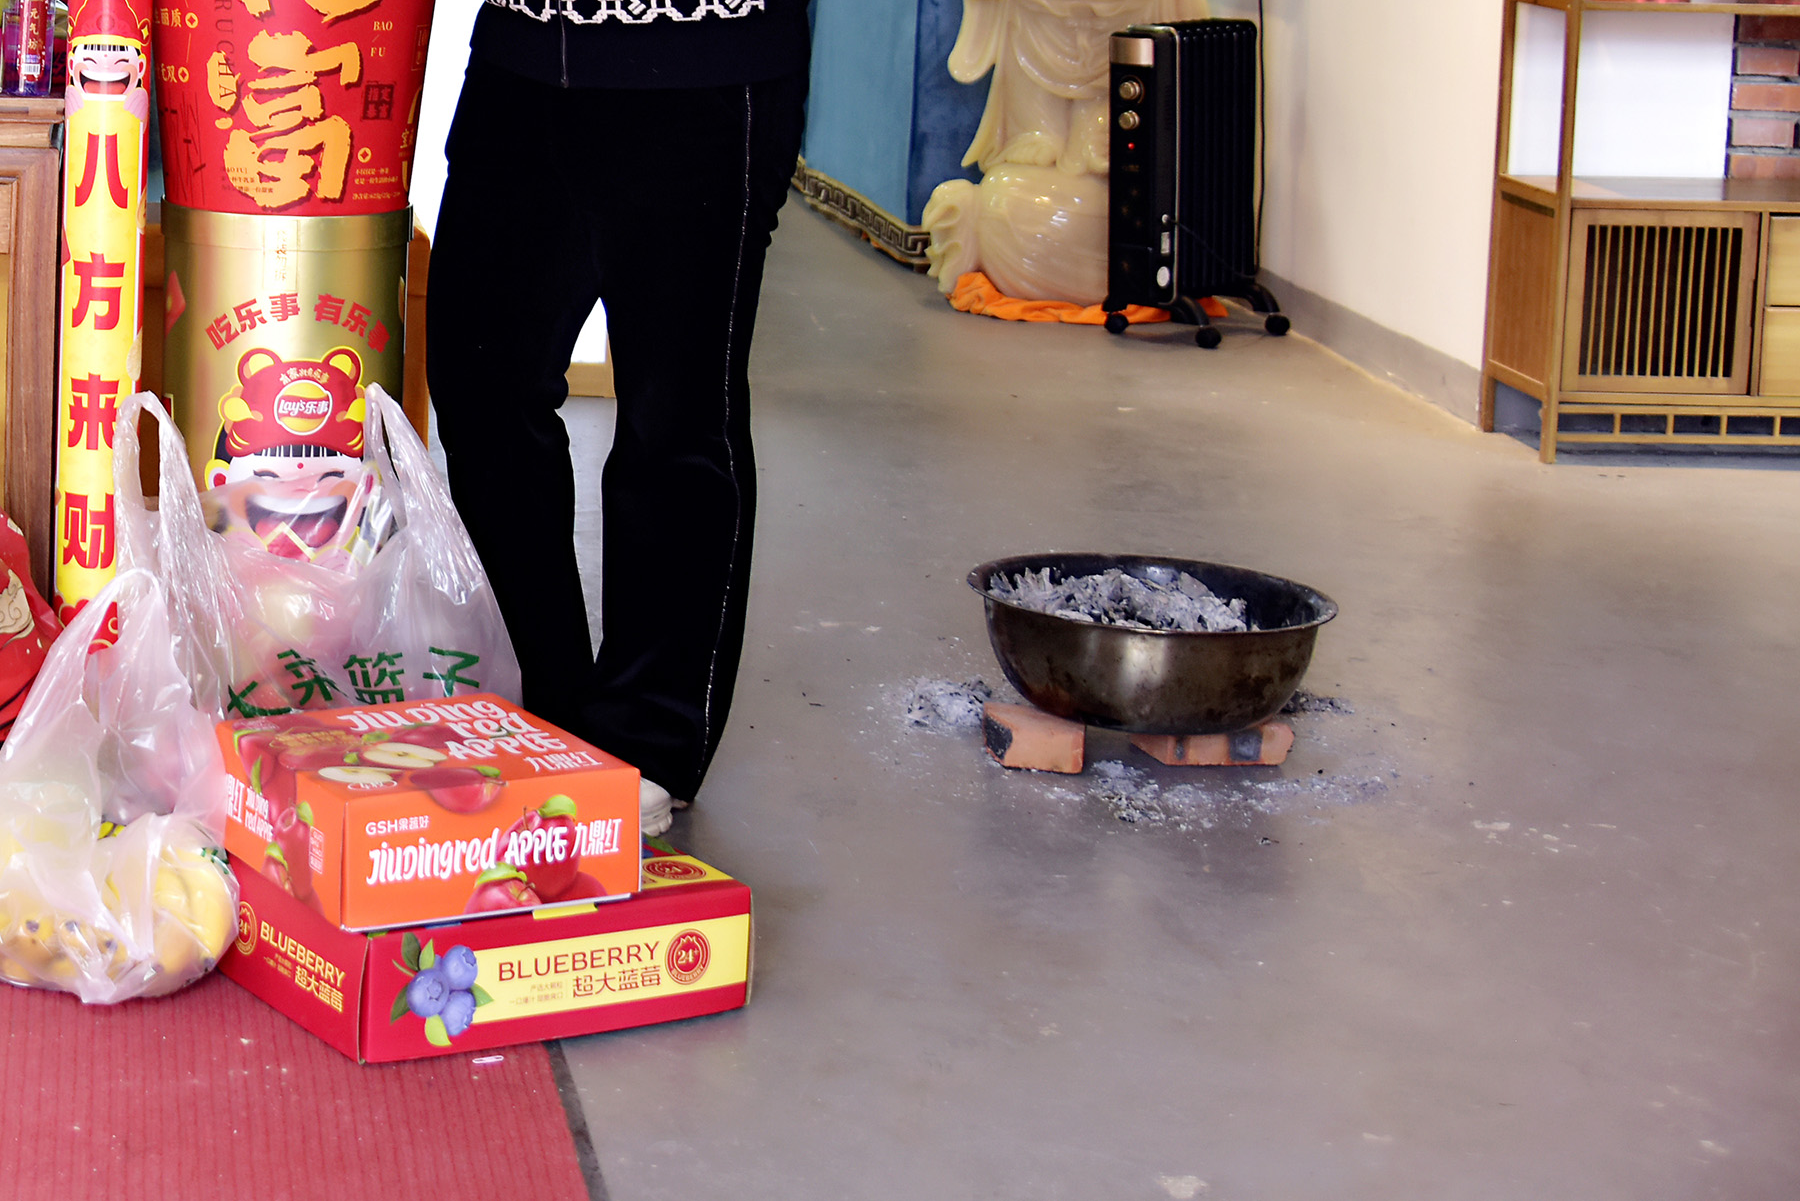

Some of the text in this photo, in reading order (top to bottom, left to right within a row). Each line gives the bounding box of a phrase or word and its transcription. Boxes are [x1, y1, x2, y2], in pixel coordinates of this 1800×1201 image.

[373, 21, 393, 31] BAO
[370, 47, 386, 57] FU
[204, 293, 390, 354] 吃乐事 有乐事
[63, 133, 130, 570] 八方来财
[446, 712, 541, 738] red
[445, 732, 567, 760] APPLE
[524, 751, 602, 772] 九鼎红
[505, 826, 568, 866] APPLE
[571, 818, 622, 858] 九鼎红
[260, 920, 345, 987] BLUEBERRY
[498, 941, 660, 981] BLUEBERRY
[295, 964, 343, 1013] 超大蓝莓
[572, 965, 661, 999] 超大蓝莓
